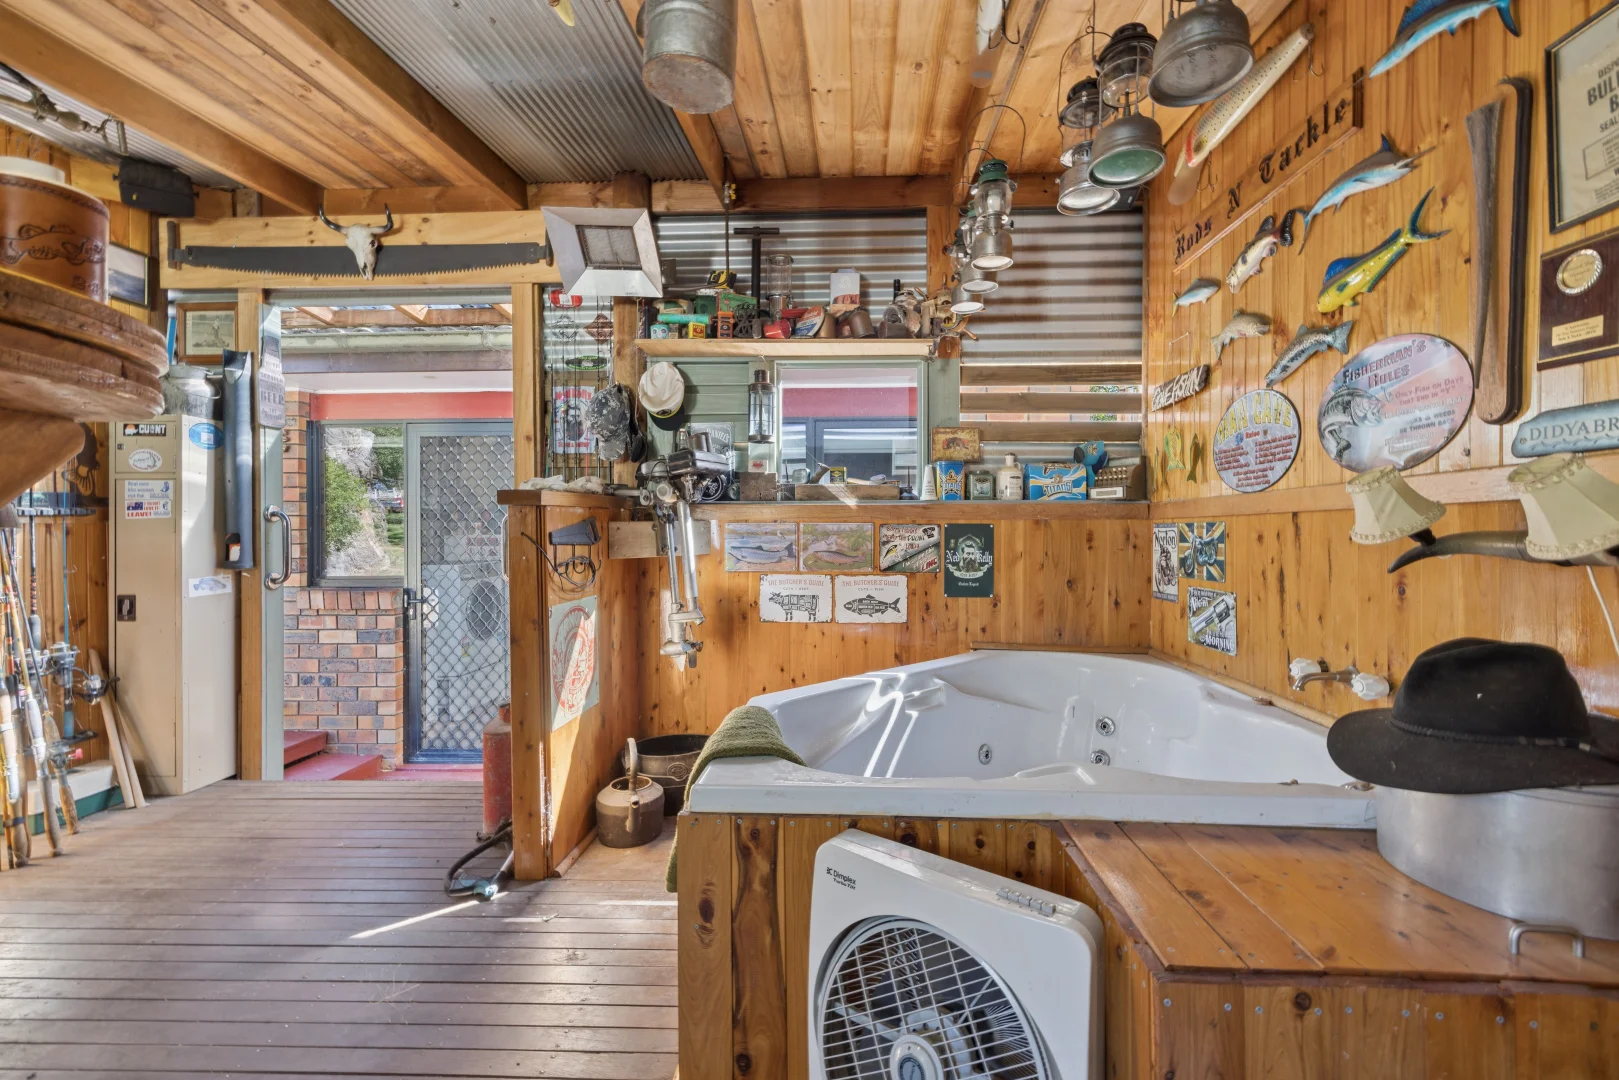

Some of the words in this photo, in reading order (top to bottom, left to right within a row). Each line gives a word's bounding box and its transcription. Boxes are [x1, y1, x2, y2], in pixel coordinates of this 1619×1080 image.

[1258, 97, 1351, 184] Tackle
[1343, 339, 1427, 384] FISHERMAN'S
[1368, 364, 1411, 389] RULES
[1395, 390, 1413, 398] ONLY
[1415, 385, 1431, 394] FISH
[1432, 382, 1442, 390] ON
[1444, 375, 1464, 387] DAYS
[1416, 394, 1430, 402] END
[1217, 395, 1249, 446] MAN
[1253, 391, 1293, 428] CAVE
[1433, 409, 1456, 418] WEEDS
[1409, 422, 1436, 432] THROWN
[1044, 480, 1073, 496] TITANS
[1153, 529, 1177, 549] Norton
[945, 550, 960, 563] Ned
[975, 550, 993, 565] Kelly
[1202, 634, 1235, 653] MORNING
[833, 869, 856, 886] Dimplex
